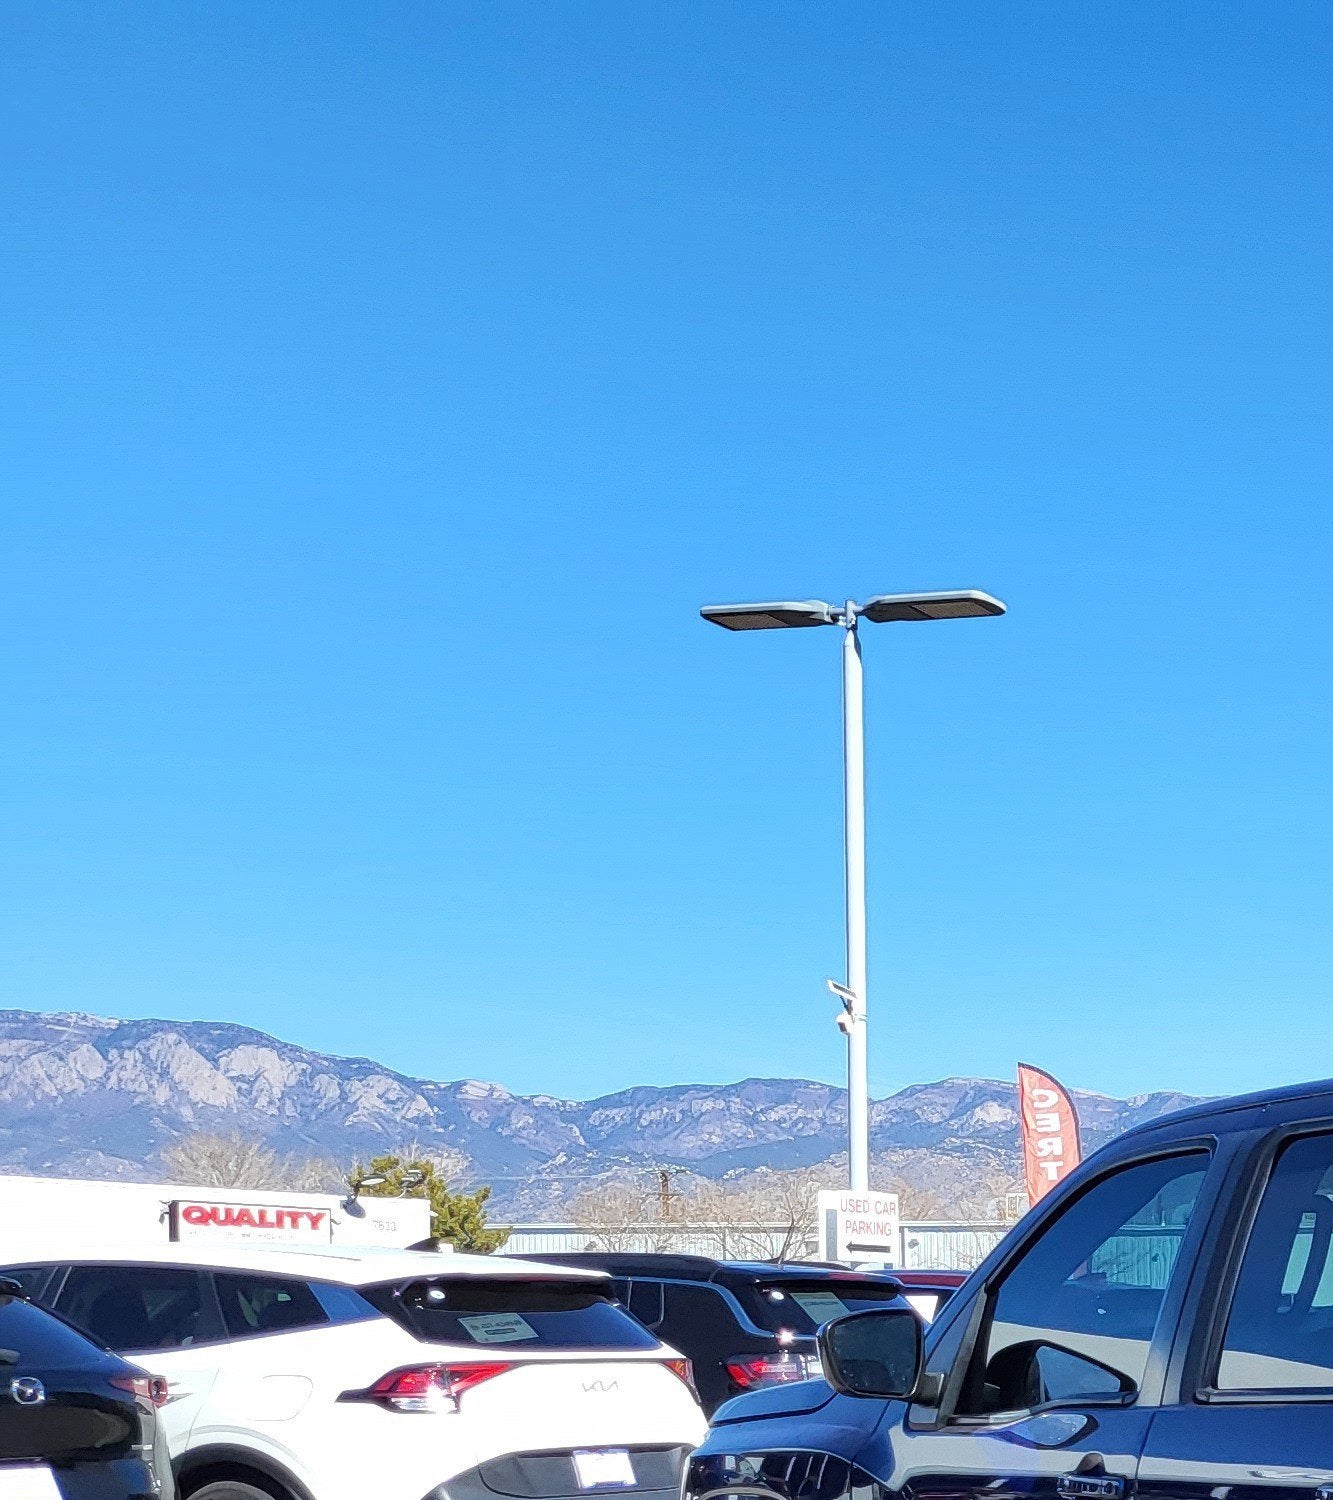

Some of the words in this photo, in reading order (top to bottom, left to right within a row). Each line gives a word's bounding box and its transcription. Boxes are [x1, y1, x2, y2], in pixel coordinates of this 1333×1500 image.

[840, 1198, 870, 1214] USED
[874, 1200, 896, 1216] CAR
[181, 1204, 327, 1231] QUALITY
[845, 1219, 892, 1237] PARKING
